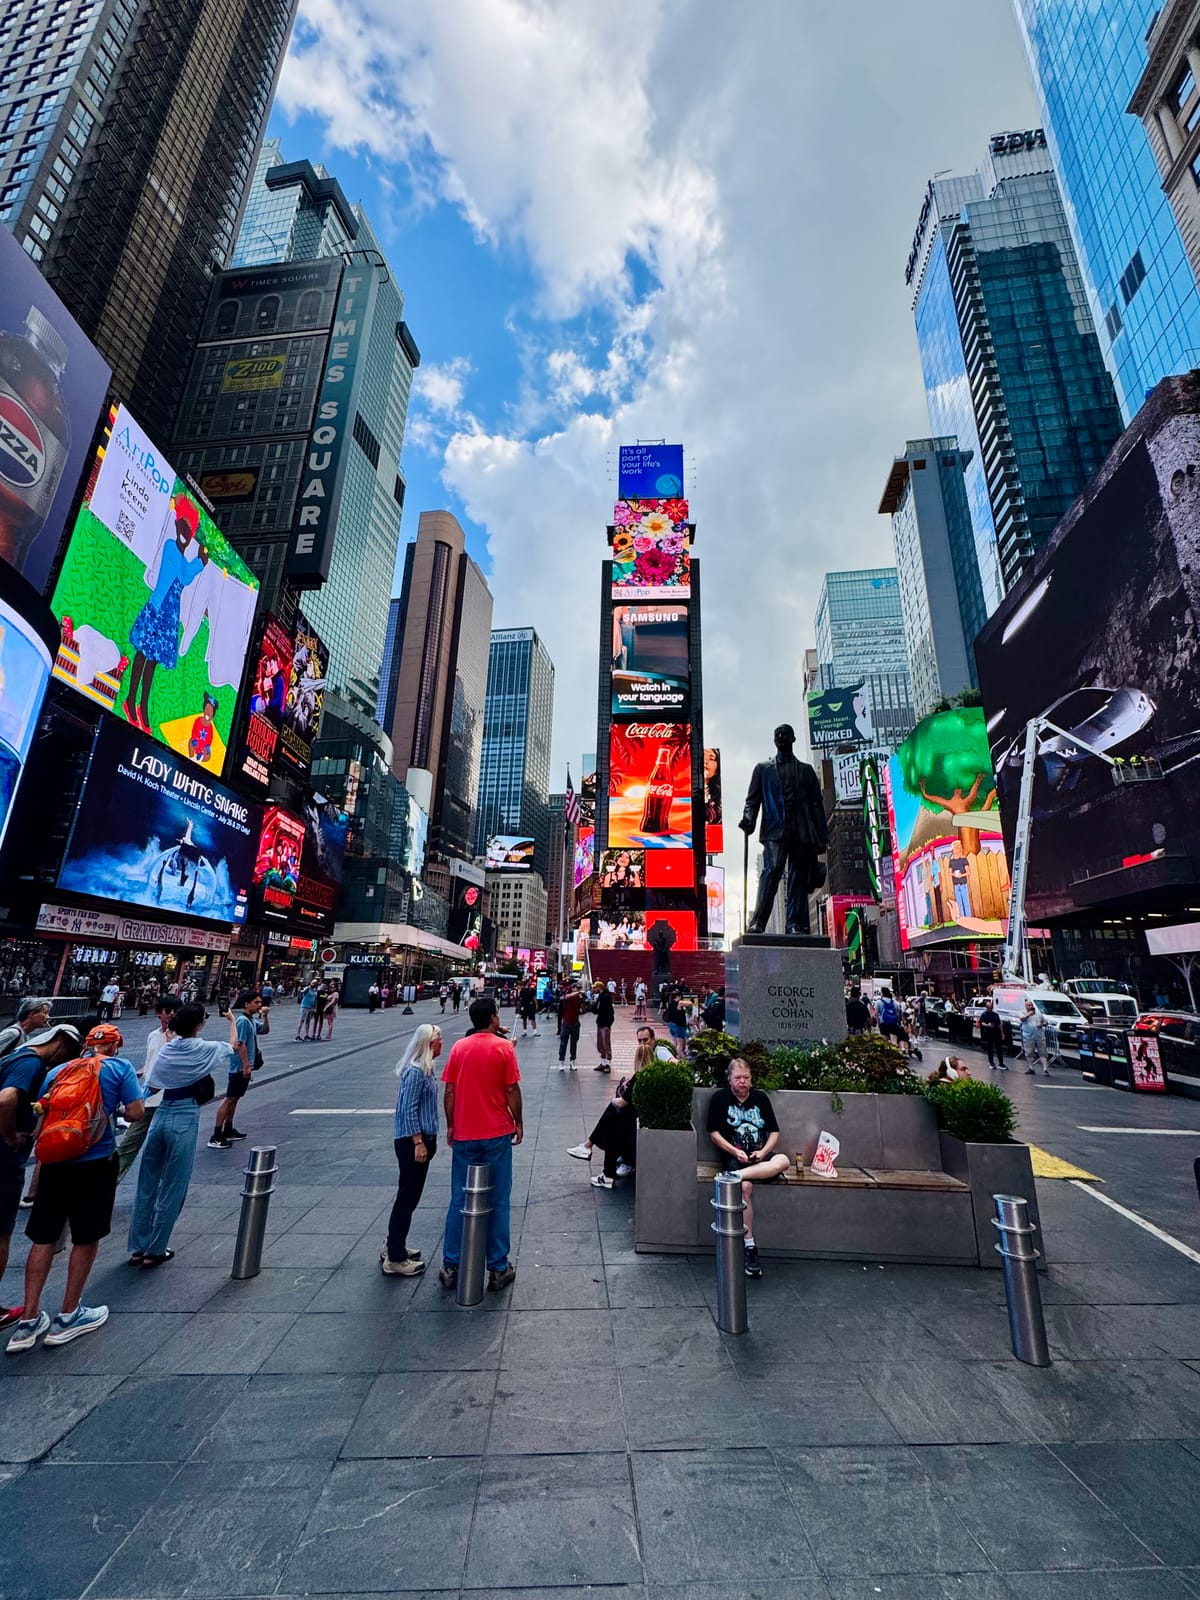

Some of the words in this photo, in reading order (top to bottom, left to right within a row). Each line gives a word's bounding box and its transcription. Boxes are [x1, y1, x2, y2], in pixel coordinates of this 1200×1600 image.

[250, 279, 278, 287] TIMES
[281, 273, 320, 283] SQUARE
[327, 276, 362, 383] TIMES
[233, 361, 277, 378] Z100
[0, 420, 38, 474] ZZA
[116, 437, 134, 461] STREET
[136, 463, 159, 489] GALLERY
[118, 426, 170, 494] ArtPop
[125, 469, 150, 502] Linda
[295, 401, 341, 555] SQUARE
[121, 480, 148, 513] Keene
[623, 613, 678, 621] SAMSUNG
[491, 632, 516, 640] Allianz
[631, 683, 660, 691] Watch
[617, 694, 638, 703] your
[640, 693, 684, 703] language
[249, 714, 278, 745] MOULIN
[839, 752, 866, 770] LITTLE
[867, 751, 889, 762] SHOP
[117, 764, 136, 780] David
[137, 775, 144, 784] H.
[144, 777, 159, 791] Koch
[160, 785, 180, 800] Theater
[184, 797, 200, 810] Lincoln
[200, 806, 215, 818] Center
[131, 747, 172, 782] LADY
[172, 770, 214, 805] WHITE
[213, 793, 248, 823] SNAKE
[864, 765, 882, 893] CANNABIS
[57, 907, 77, 917] SPORTS
[88, 912, 100, 920] SHOP
[269, 931, 281, 941] BLUE
[282, 934, 291, 942] FIN
[76, 948, 117, 964] GRAND
[135, 951, 163, 967] SLAM
[350, 955, 385, 963] KLIKTIX
[768, 986, 815, 998] GEORGE
[772, 1007, 814, 1019] COHAN
